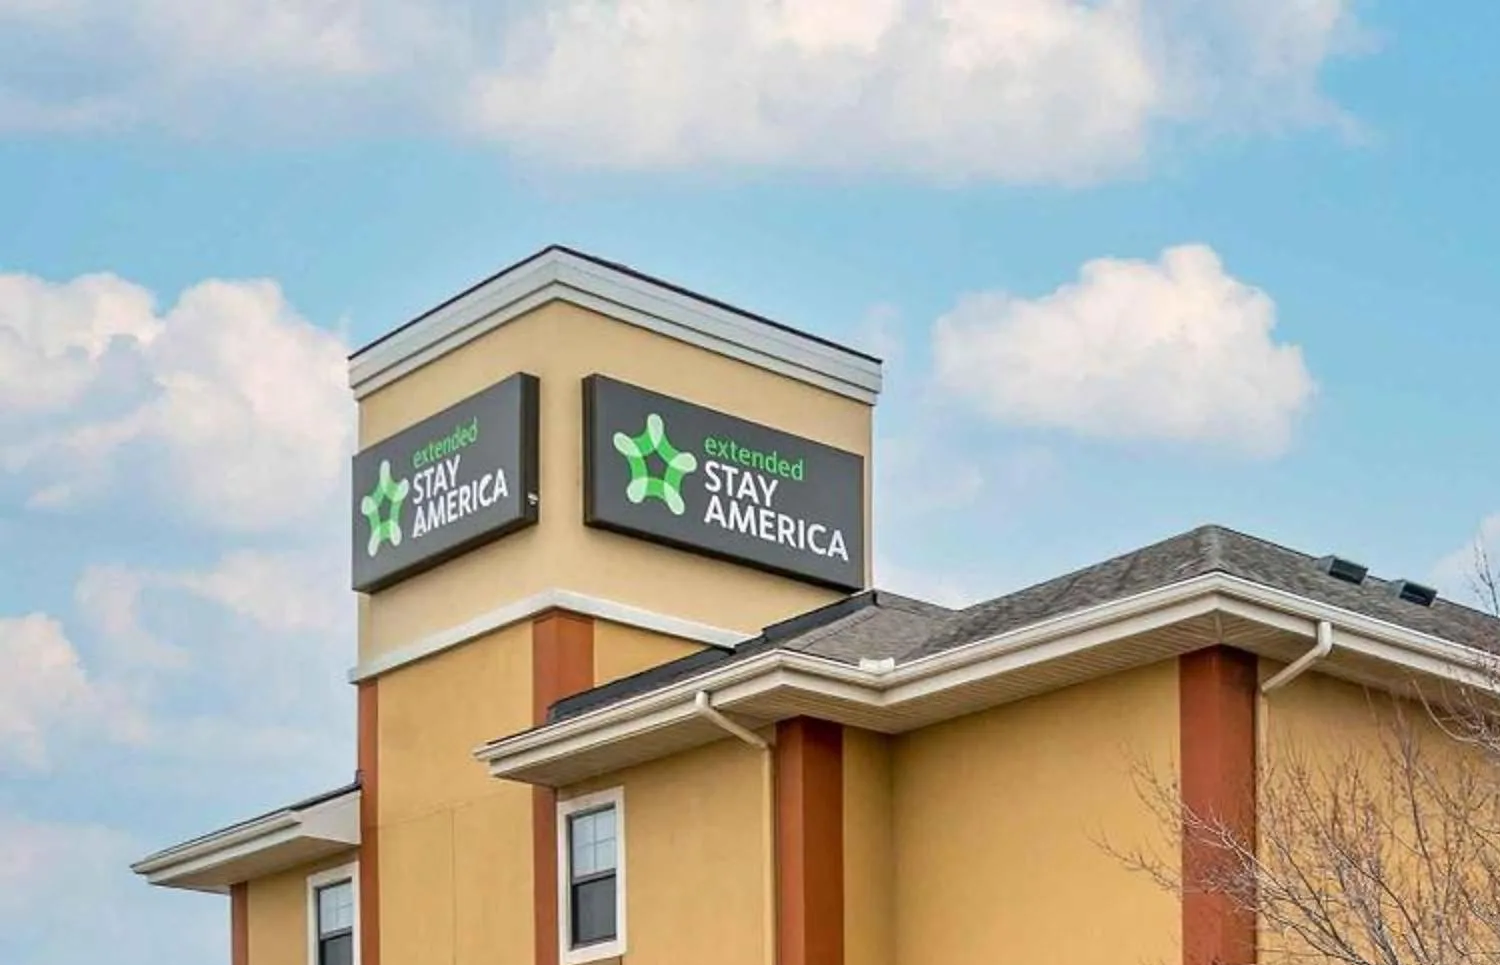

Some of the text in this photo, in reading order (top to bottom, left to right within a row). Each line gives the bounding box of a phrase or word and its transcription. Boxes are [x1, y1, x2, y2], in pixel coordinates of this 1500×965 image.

[413, 415, 478, 469] extended
[704, 437, 803, 481] extended
[412, 468, 508, 538] AMERICA
[413, 454, 461, 504] STAY
[704, 460, 779, 507] STAY
[704, 494, 849, 561] AMERICA
